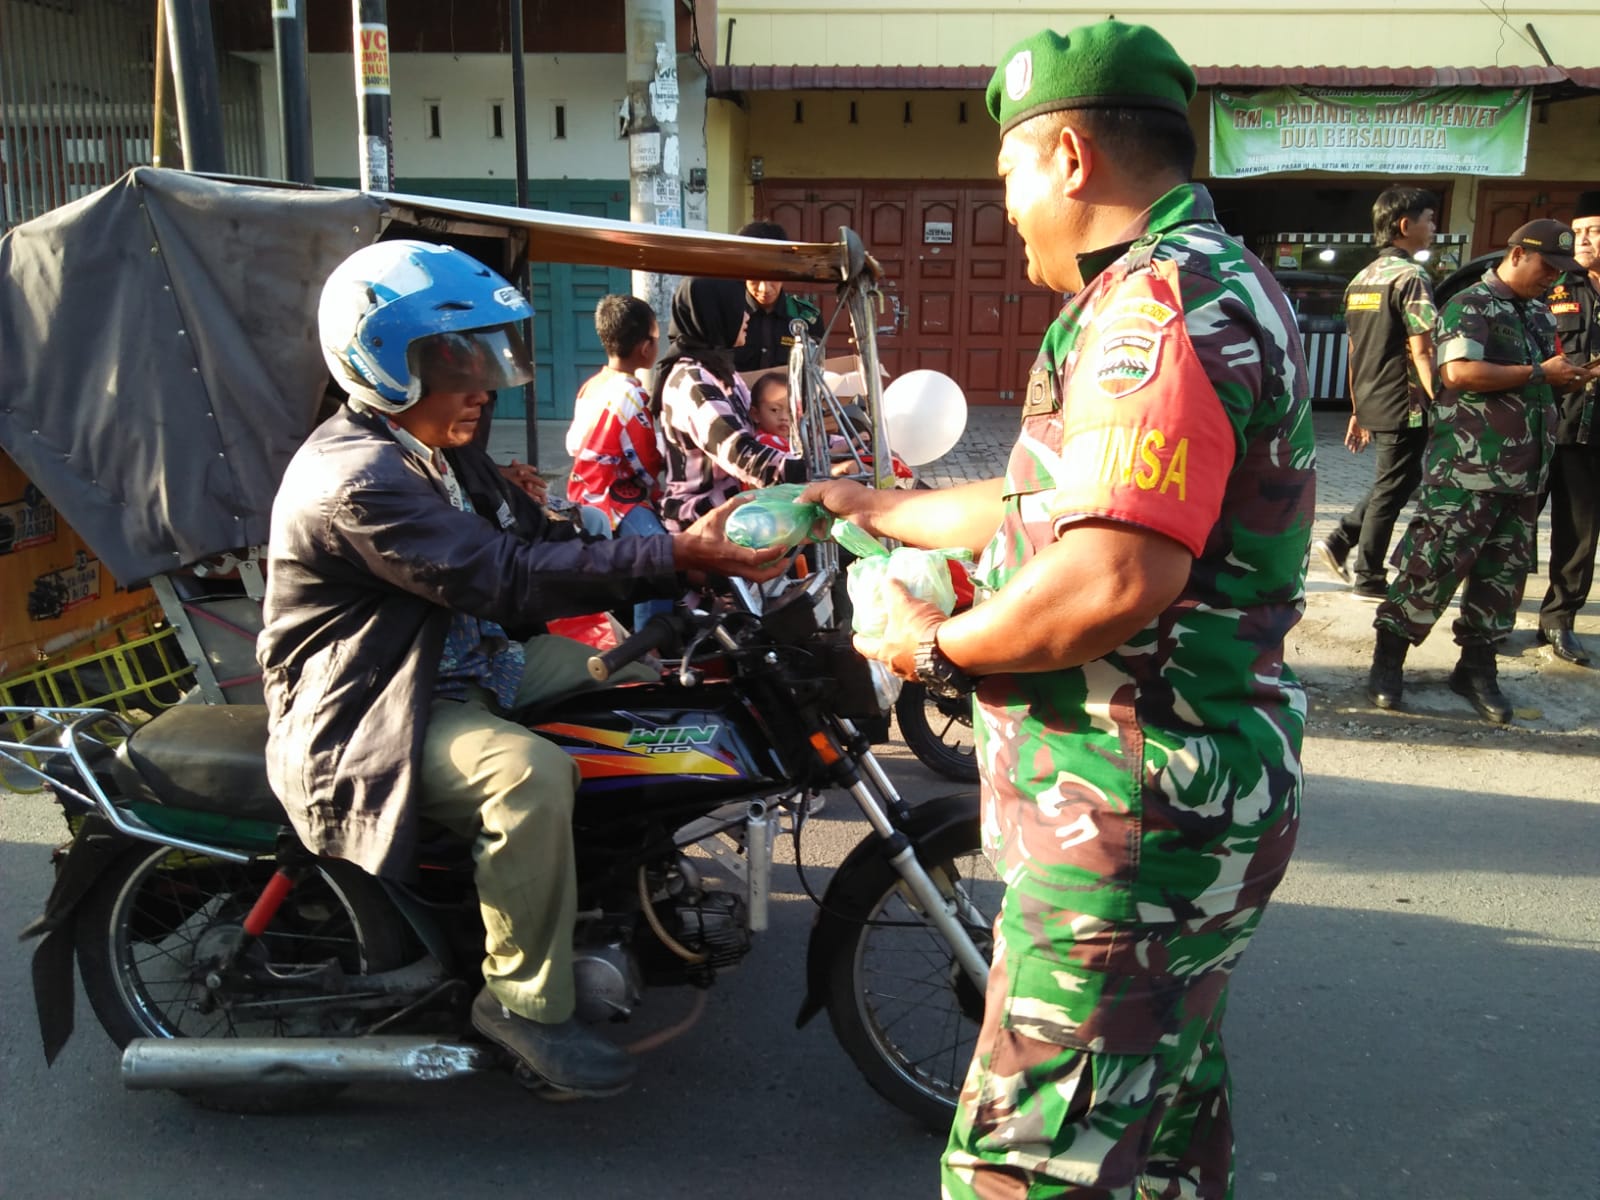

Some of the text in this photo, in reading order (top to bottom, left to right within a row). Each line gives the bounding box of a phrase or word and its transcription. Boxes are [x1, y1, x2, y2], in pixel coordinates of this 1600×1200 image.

[1275, 102, 1352, 126] PADANG
[1356, 106, 1370, 124] &
[1374, 103, 1427, 125] AYAM
[1430, 103, 1500, 128] PENYET
[1280, 127, 1448, 149] DUA BERSAUDARA
[624, 725, 719, 747] WIN
